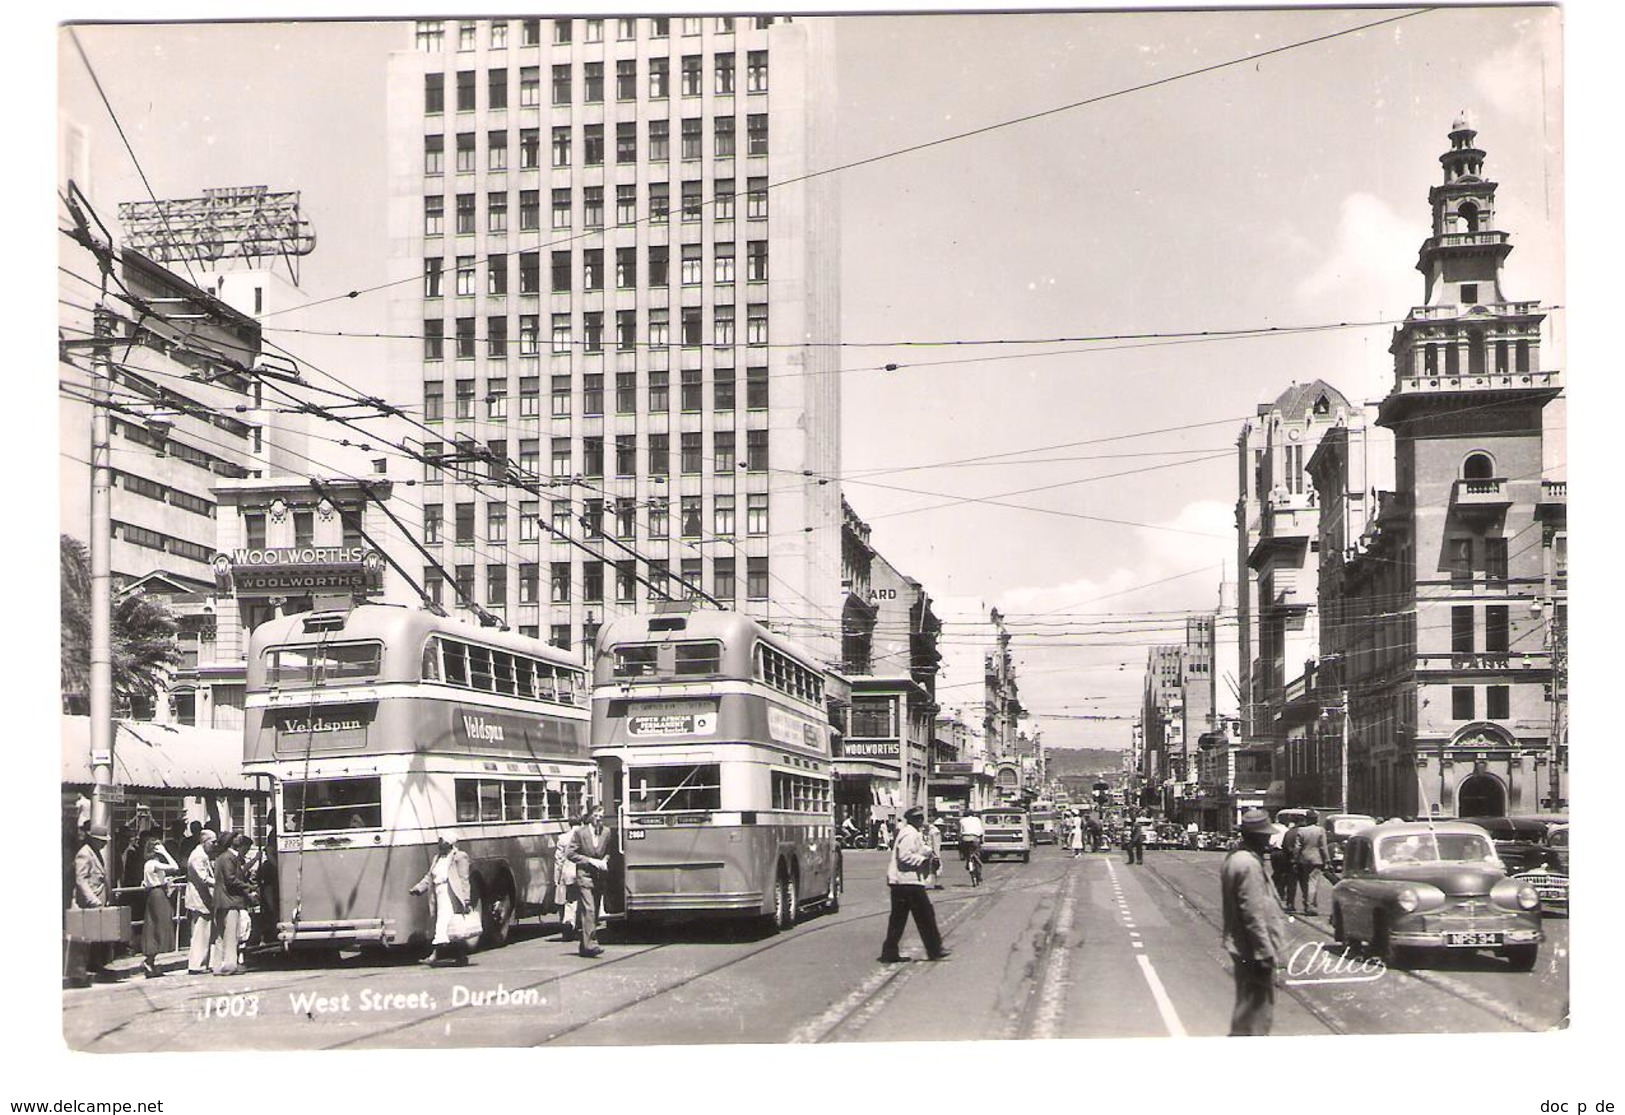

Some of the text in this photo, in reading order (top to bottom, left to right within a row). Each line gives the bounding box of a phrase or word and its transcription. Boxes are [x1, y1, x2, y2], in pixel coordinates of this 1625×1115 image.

[234, 548, 363, 564] WOOLWORTHS
[243, 576, 363, 588] WOOLWORTHS
[284, 717, 361, 734] Veldspun
[463, 715, 504, 743] Veldspun
[844, 743, 900, 755] WOOLWORTHS
[1452, 932, 1496, 945] NPS 34
